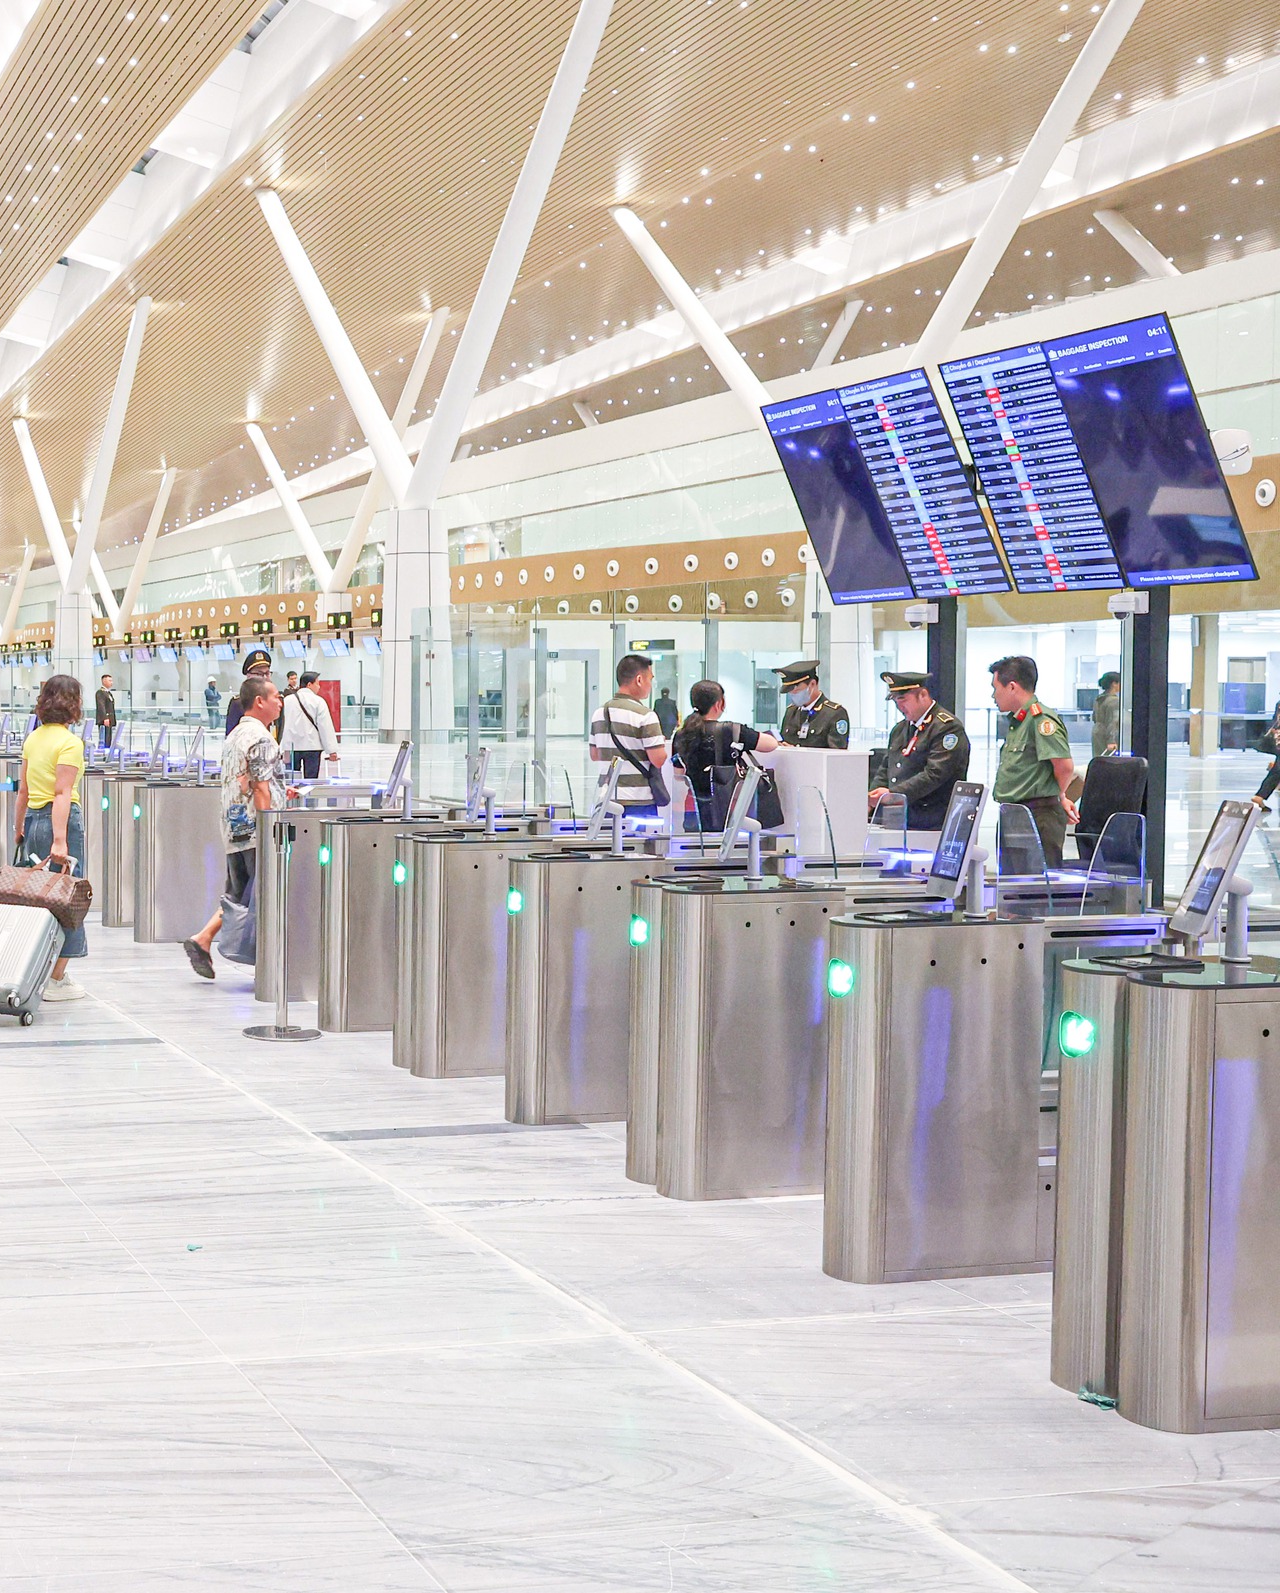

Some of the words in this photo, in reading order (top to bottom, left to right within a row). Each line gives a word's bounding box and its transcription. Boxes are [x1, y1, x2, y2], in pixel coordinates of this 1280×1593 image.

[1147, 326, 1167, 338] 04:11
[1057, 344, 1089, 358] BAGGAGE
[1088, 335, 1129, 351] INSPECTION
